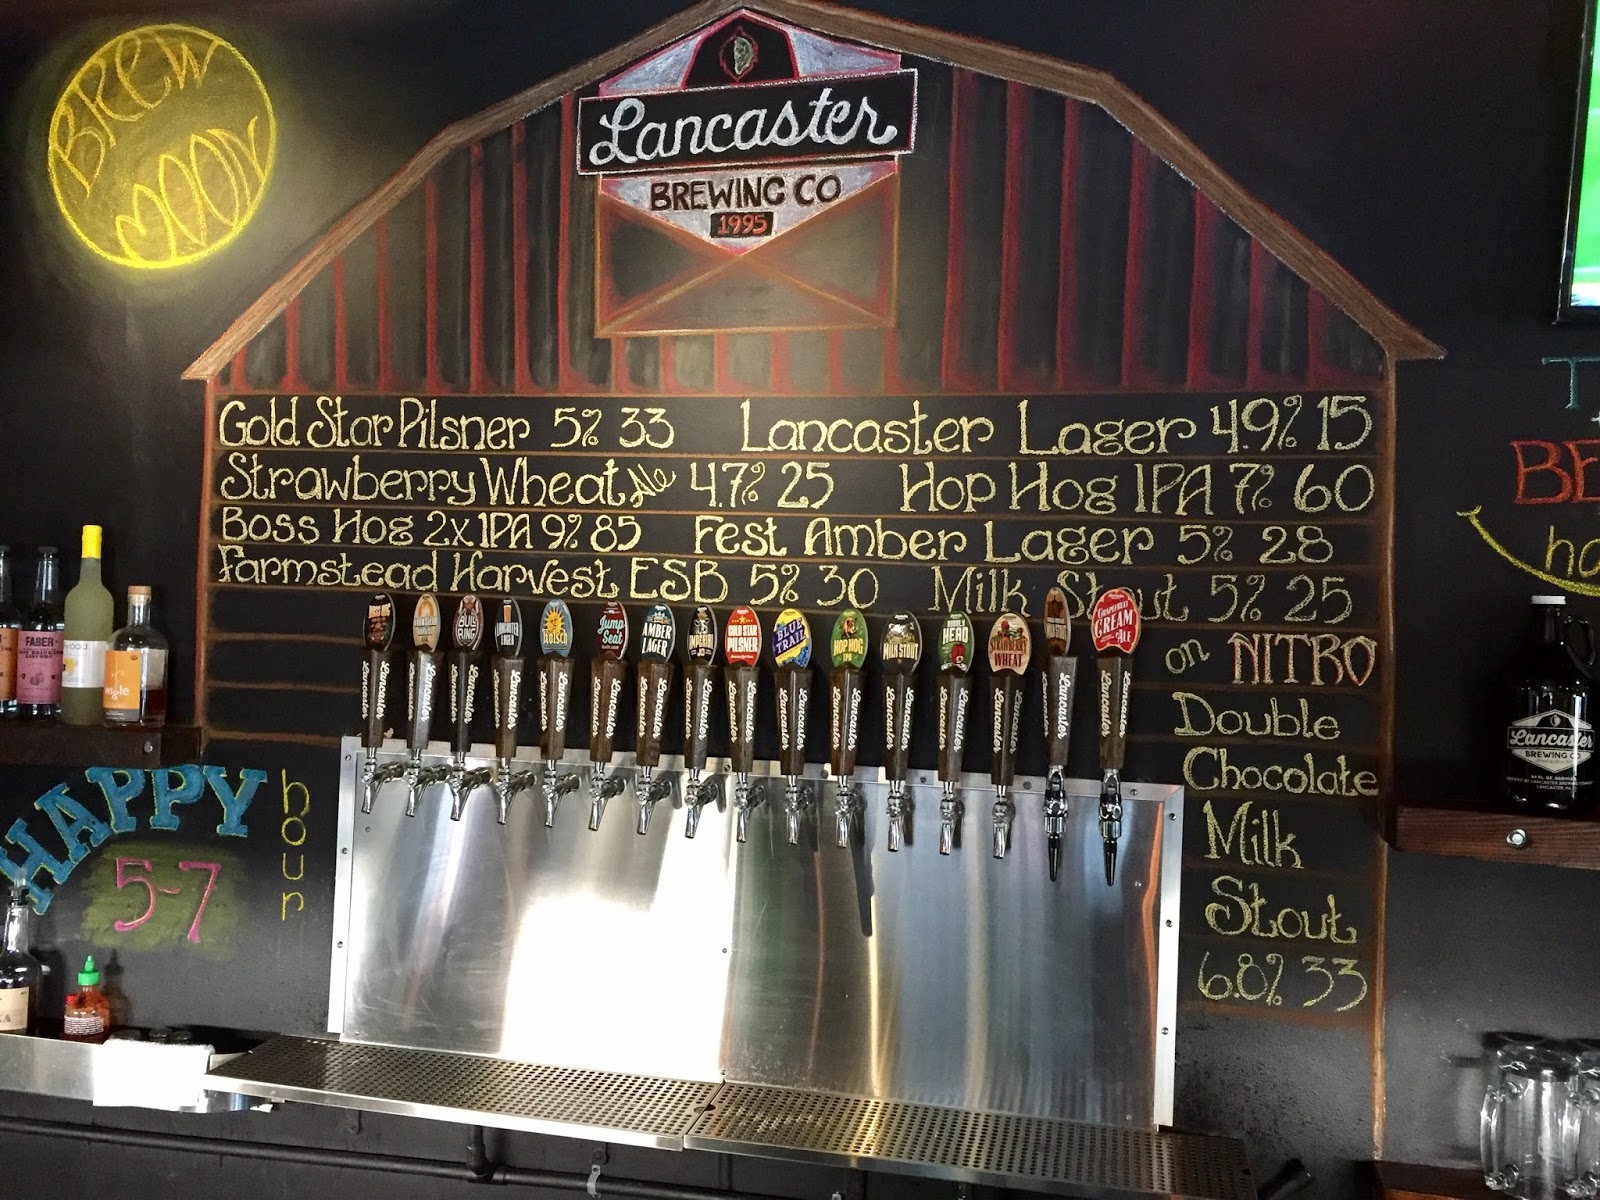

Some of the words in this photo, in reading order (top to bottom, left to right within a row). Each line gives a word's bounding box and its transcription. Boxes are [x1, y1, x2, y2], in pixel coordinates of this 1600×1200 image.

[588, 87, 898, 166] Lancaster
[650, 173, 785, 211] BREWING
[794, 173, 842, 206] CO
[719, 213, 768, 234] 1995
[218, 395, 301, 447] Gold
[306, 395, 394, 449] Star
[397, 397, 531, 451] Pilsner
[550, 407, 603, 448] 5%
[619, 407, 675, 449] 33
[739, 398, 994, 455] Lancaster
[1017, 399, 1197, 456] Lager
[1209, 394, 1303, 454] 4.9%
[1316, 395, 1373, 451] 15
[219, 452, 477, 506] Strawberry
[479, 456, 627, 508] Wheat
[690, 461, 766, 508] 4.7%
[777, 460, 835, 510] 25
[898, 460, 996, 513] Hop
[1007, 461, 1119, 515] Hog
[1133, 463, 1214, 516] IPA
[1229, 462, 1275, 515] 7%
[1292, 463, 1375, 513] 60
[221, 507, 321, 544] Boss
[331, 508, 414, 546] Hog
[422, 509, 475, 547] 2x
[477, 512, 534, 549] IPA
[541, 513, 583, 550] 9%
[590, 514, 642, 553] 85
[693, 514, 788, 557] Fest
[803, 517, 967, 561] Amber
[983, 520, 1155, 565] Lager
[1176, 524, 1234, 565] 5%
[1258, 525, 1334, 564] 28
[217, 544, 438, 592] Farmstead
[449, 550, 620, 598] Harvest
[629, 556, 729, 604] ESB
[749, 563, 800, 606] 5%
[816, 564, 879, 609] 30
[927, 565, 1030, 618] Milk
[1055, 568, 1192, 623] Stut
[1207, 574, 1266, 623] 5%
[1284, 574, 1353, 625] 25
[25, 636, 54, 648] FABER
[597, 615, 625, 634] Jump
[602, 632, 623, 645] Seat
[641, 637, 667, 658] LAGER
[642, 622, 672, 640] AMBER
[727, 637, 759, 653] PILSNER
[775, 629, 806, 655] TRAIL
[777, 618, 803, 642] BLUE
[833, 639, 848, 656] HOP
[849, 638, 864, 655] HOG
[883, 643, 898, 660] MILK
[899, 643, 919, 660] STOUT
[942, 627, 969, 645] HEAD
[1094, 609, 1133, 638] CREAM
[994, 652, 1022, 667] WHEAT
[1165, 638, 1211, 674] on
[1227, 631, 1378, 687] NITRO
[421, 661, 436, 722] Lancaster
[507, 669, 521, 730] Lancaster
[605, 677, 621, 740] Lancaster
[652, 677, 667, 740] Lancaster
[698, 677, 713, 741] Lancaster
[745, 680, 757, 744] Lancaster
[779, 687, 789, 751] Lancaster
[796, 687, 808, 751] Lancaster
[832, 686, 842, 751] Lancaster
[847, 686, 862, 752] Lancaster
[885, 686, 895, 751] Lancaster
[900, 687, 915, 752] Lancaster
[953, 687, 969, 753] Lancaster
[993, 687, 1005, 754] Lancaster
[1057, 672, 1071, 740] Lancaster
[1101, 669, 1113, 738] Lancaster
[1118, 670, 1132, 739] Lancaster
[1172, 691, 1341, 740] Double
[1182, 746, 1380, 796] Chocolate
[1525, 750, 1568, 759] BREWING
[0, 763, 267, 916] HAPPY
[1202, 799, 1305, 869] Milk
[113, 856, 222, 943] 5-7
[1204, 875, 1357, 944] Stout
[1197, 951, 1284, 1007] 6.8%
[1301, 955, 1368, 1012] 33
